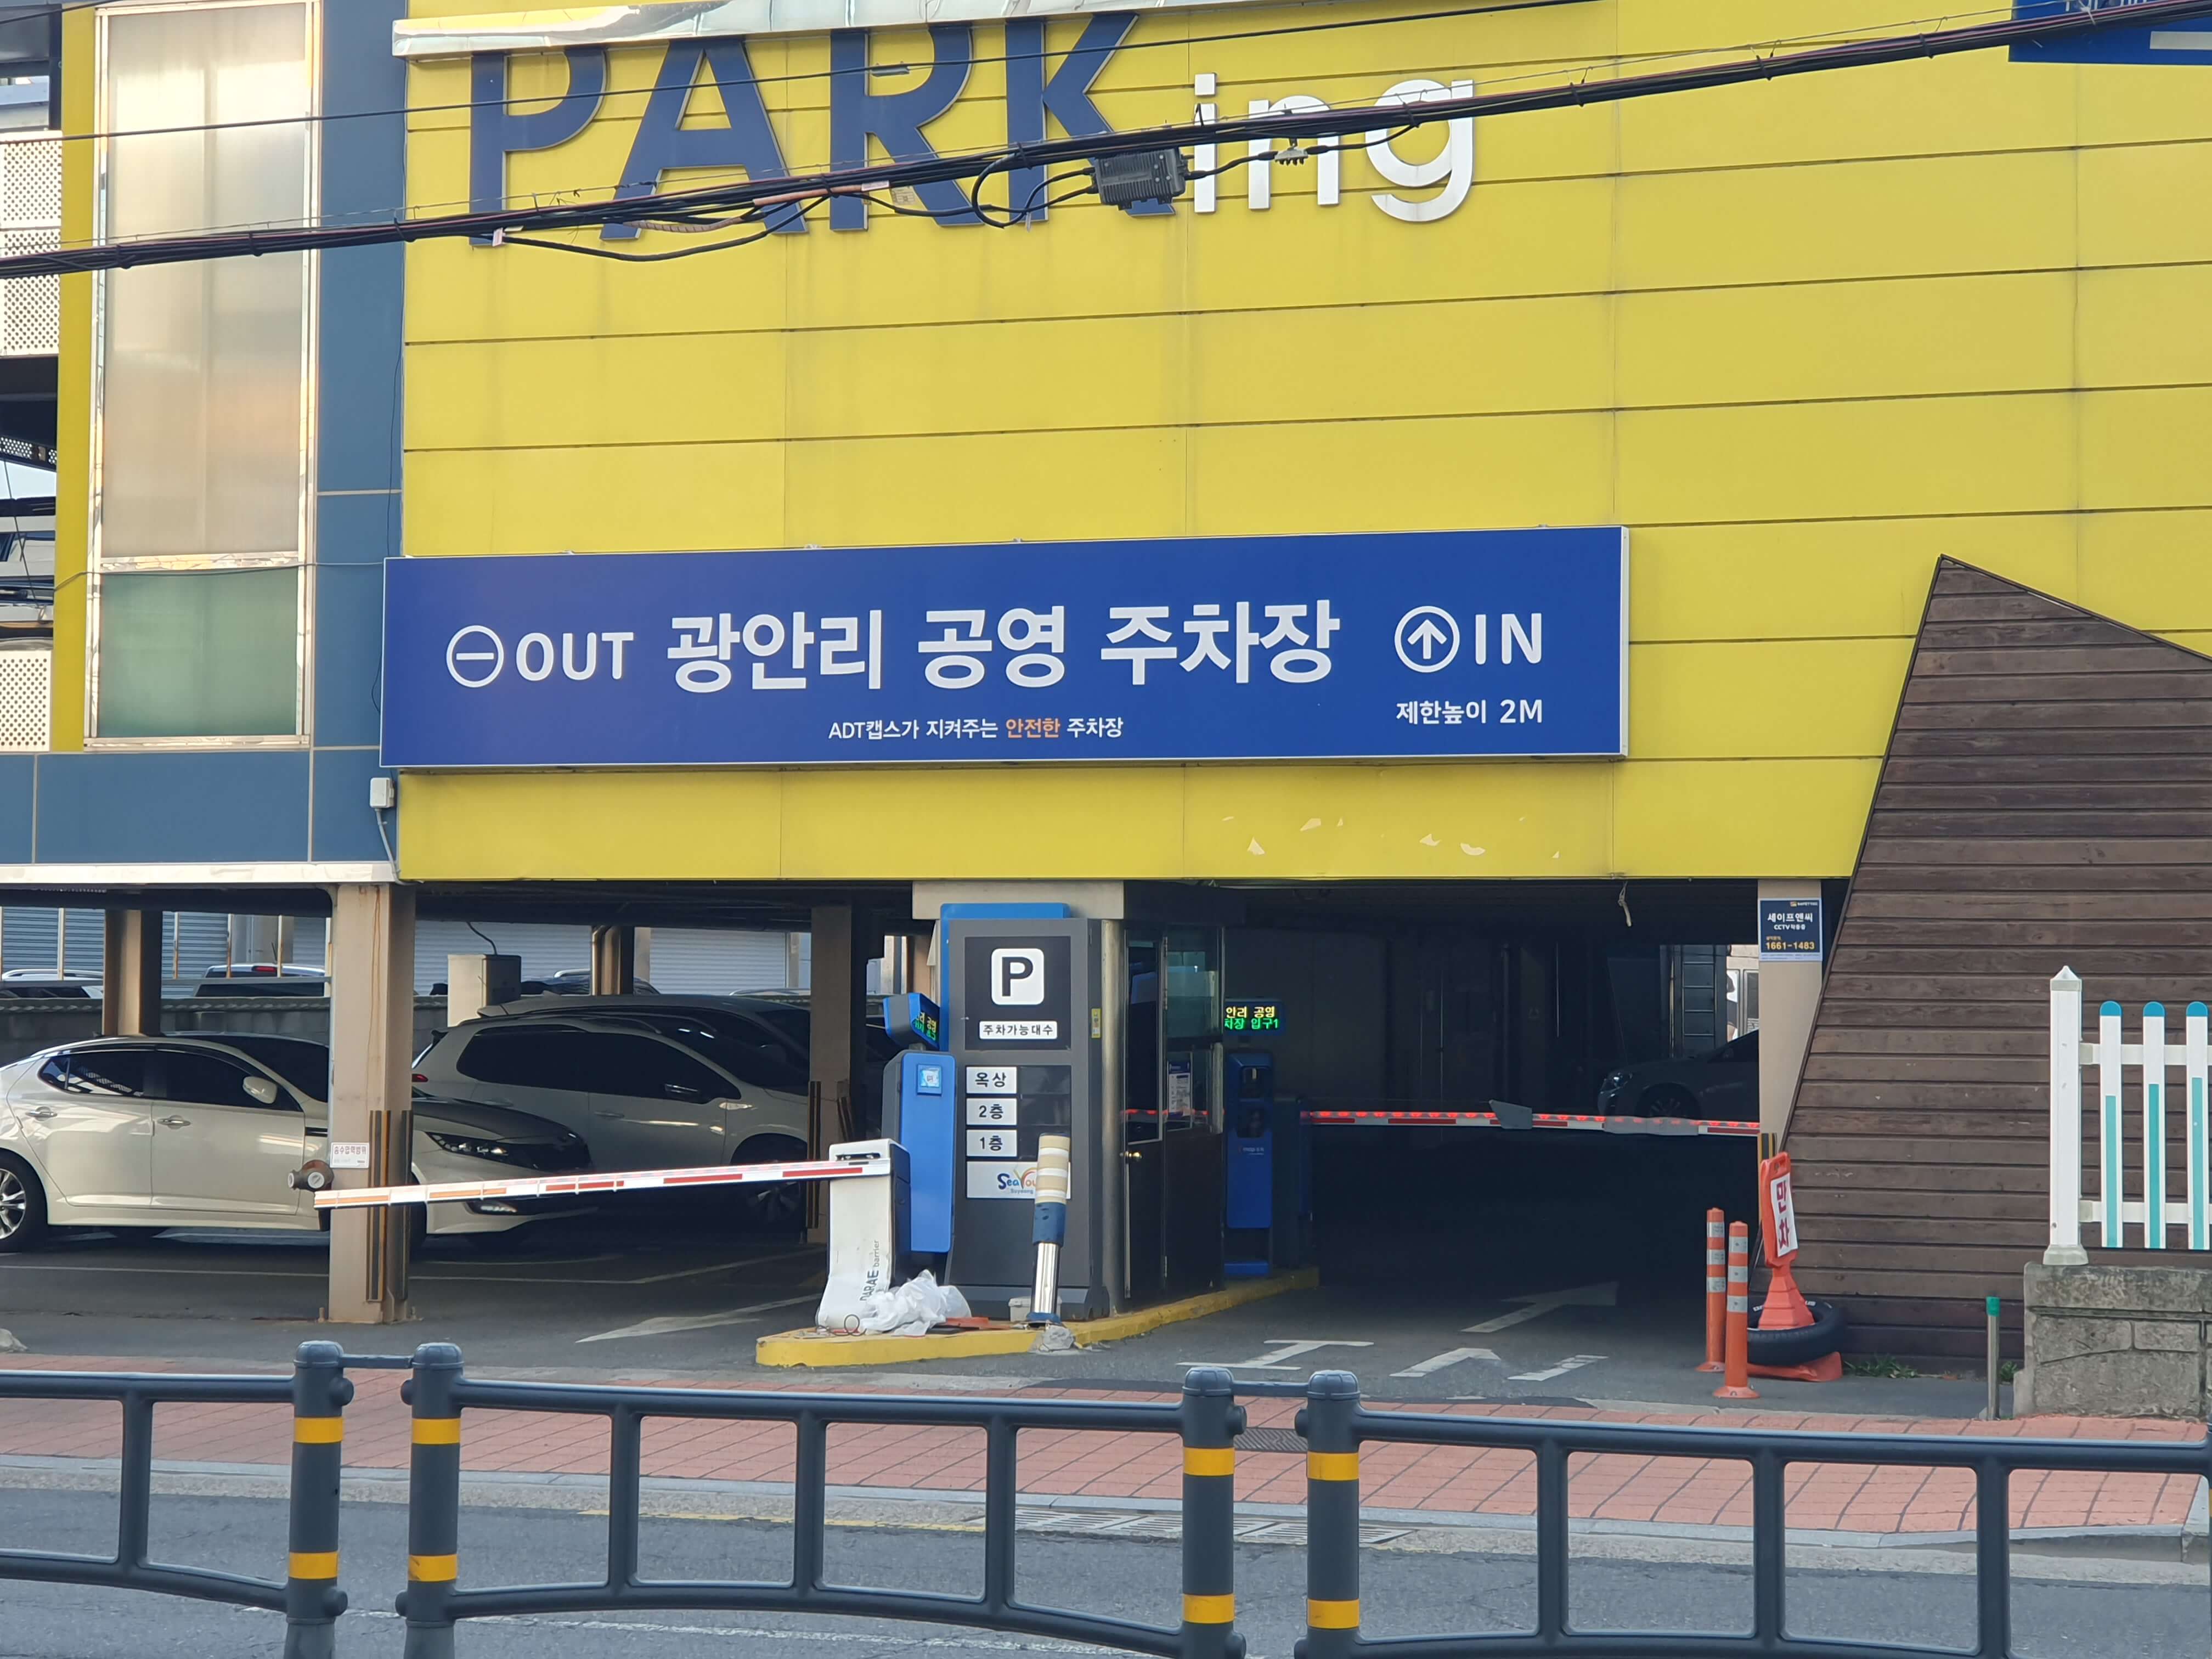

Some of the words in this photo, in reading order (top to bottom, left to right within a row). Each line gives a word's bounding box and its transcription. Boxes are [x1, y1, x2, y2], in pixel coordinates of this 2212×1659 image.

[667, 610, 882, 693] 광안리
[917, 605, 1065, 690] 공영
[1101, 599, 1340, 687] 주차장
[1475, 613, 1542, 664] IN
[516, 631, 634, 681] OUT
[1396, 699, 1486, 725] 제한높이
[1499, 699, 1542, 724] 2M
[828, 719, 919, 740] ADT캡스가
[926, 719, 998, 739] 지켜주는
[1005, 718, 1061, 738] 안전한
[1066, 717, 1124, 738] 주차장
[1766, 941, 1815, 950] 1661-1483
[1001, 956, 1034, 997] P
[1254, 1006, 1275, 1018] 공영
[983, 1024, 1053, 1036] 주차가능대수
[1250, 1018, 1279, 1030] 입구1
[975, 1072, 1007, 1088] 옥상
[978, 1103, 1003, 1120] 2층
[979, 1135, 1003, 1151] 1층
[1776, 1180, 1790, 1249] 만차
